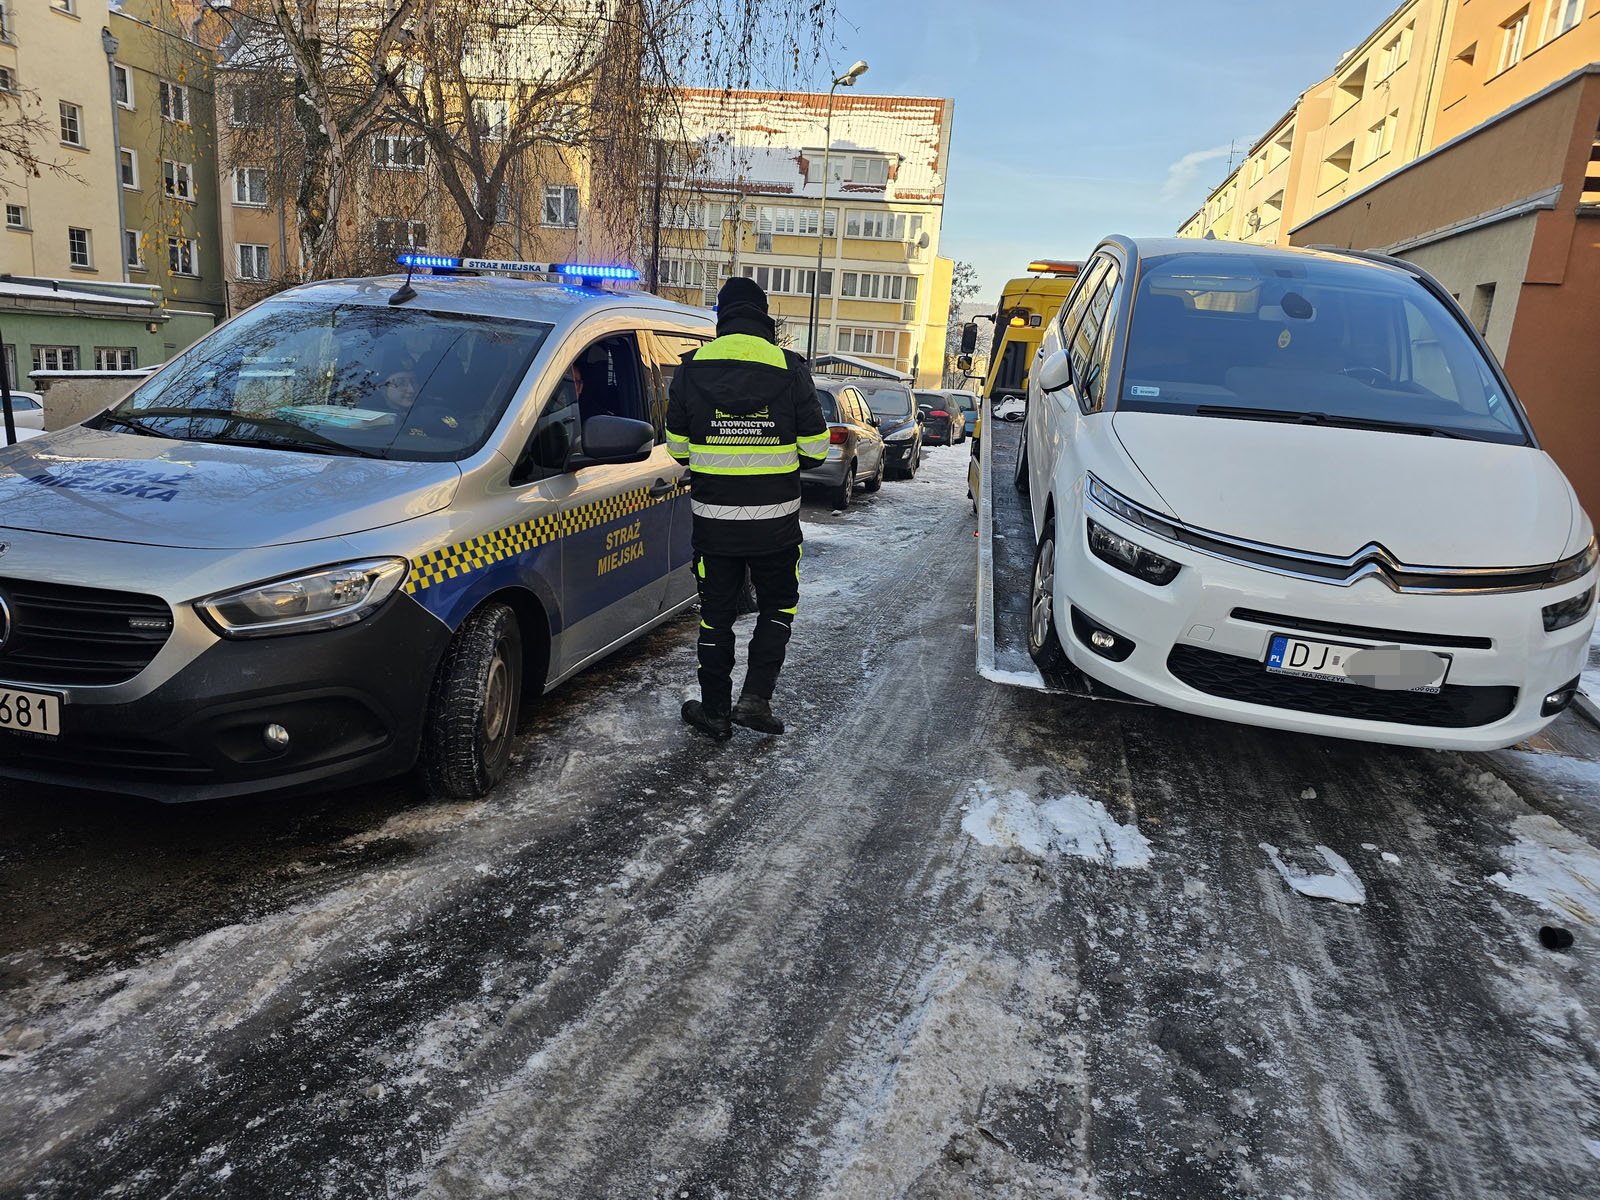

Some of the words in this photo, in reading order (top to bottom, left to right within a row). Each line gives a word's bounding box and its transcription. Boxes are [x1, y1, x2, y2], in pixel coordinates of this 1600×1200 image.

[501, 263, 541, 272] MIEJSKA
[710, 420, 776, 428] RATOWNICTWO
[72, 465, 195, 486] STRAŻ
[19, 474, 180, 502] MIEJSKA
[606, 518, 641, 551] STRAŻ
[597, 541, 645, 577] MIEJSKA
[1270, 654, 1281, 663] PL
[1301, 672, 1346, 683] MAJORCZYK
[0, 693, 47, 731] 681
